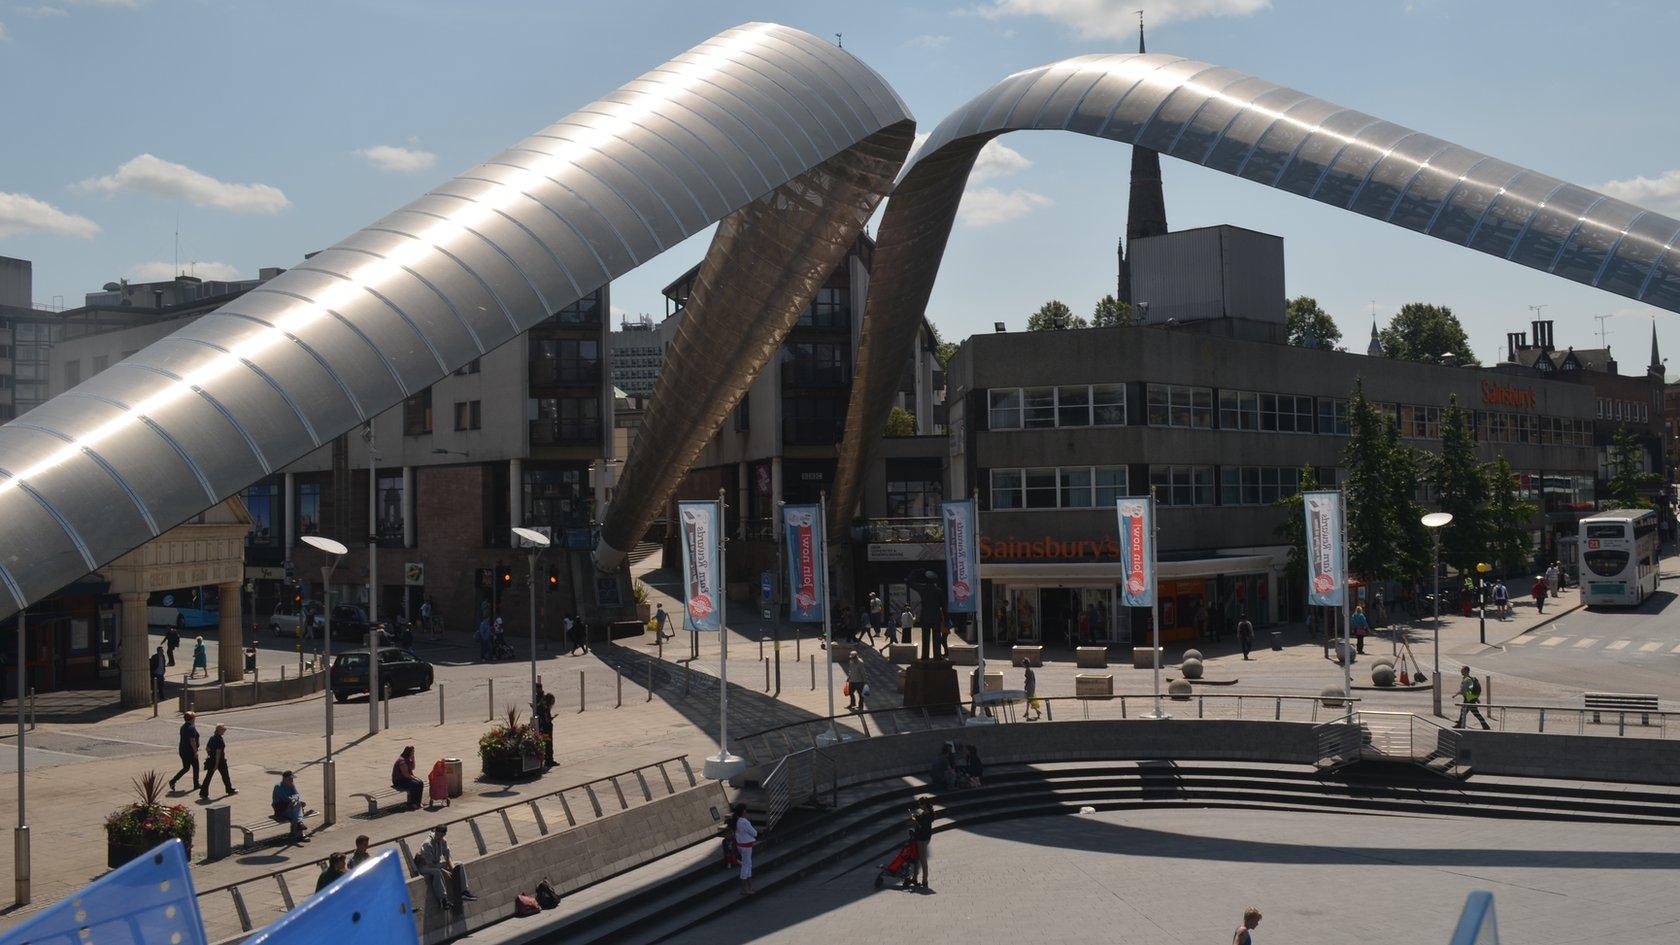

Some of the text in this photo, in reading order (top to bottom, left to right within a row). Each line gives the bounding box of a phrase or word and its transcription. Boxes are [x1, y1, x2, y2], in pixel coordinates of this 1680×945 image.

[1480, 379, 1536, 409] Sainsbury's
[801, 472, 823, 481] BBC
[980, 535, 1119, 561] Sainsbury's
